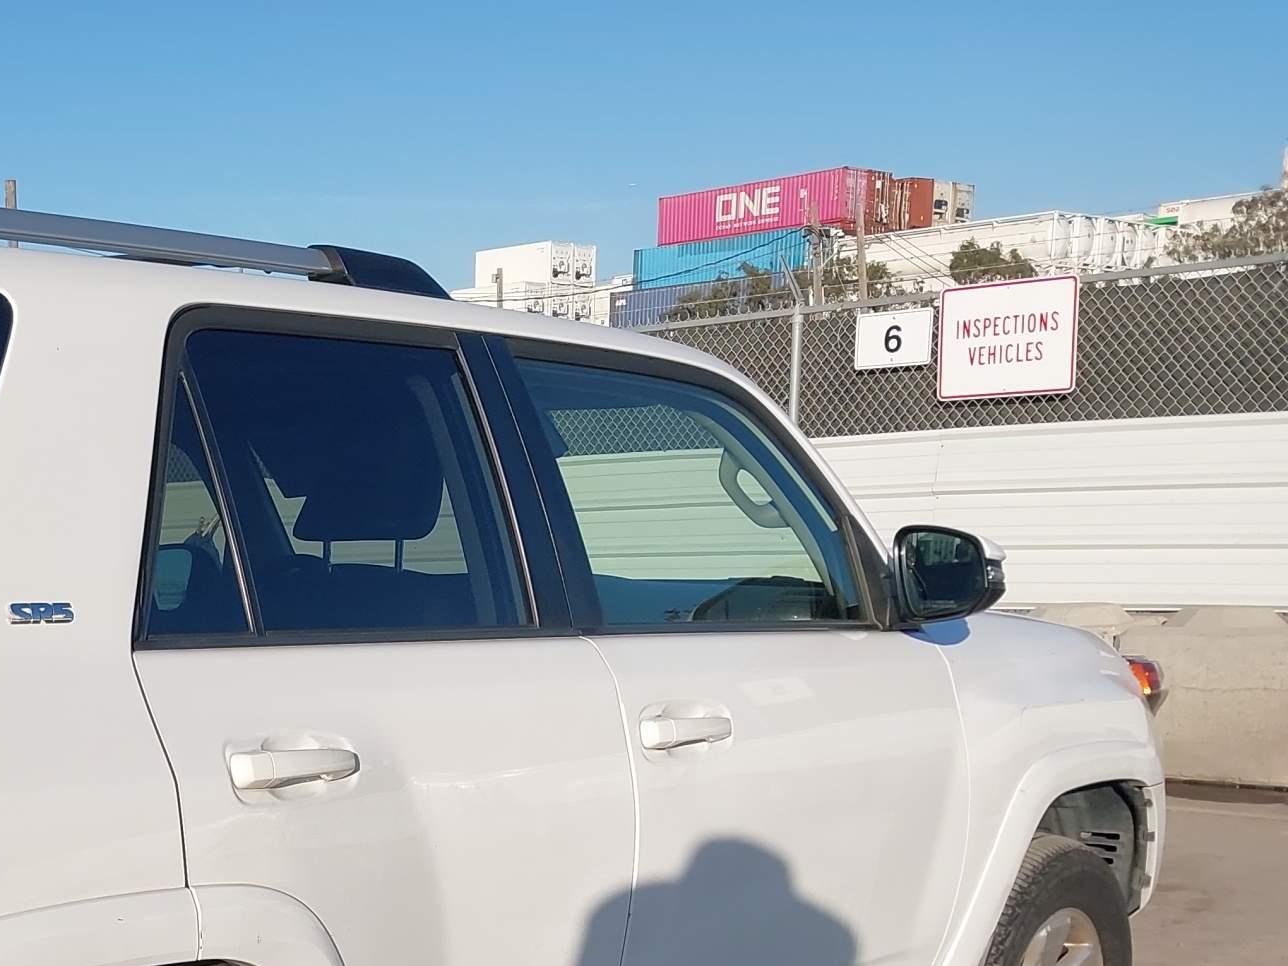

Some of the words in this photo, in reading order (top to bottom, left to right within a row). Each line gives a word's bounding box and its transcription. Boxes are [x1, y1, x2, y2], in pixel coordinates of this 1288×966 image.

[715, 185, 781, 223] ONE
[883, 324, 903, 354] 6
[955, 311, 1060, 340] INSPECTIONS
[967, 341, 1044, 367] VEHICLES
[10, 602, 74, 625] SR5
